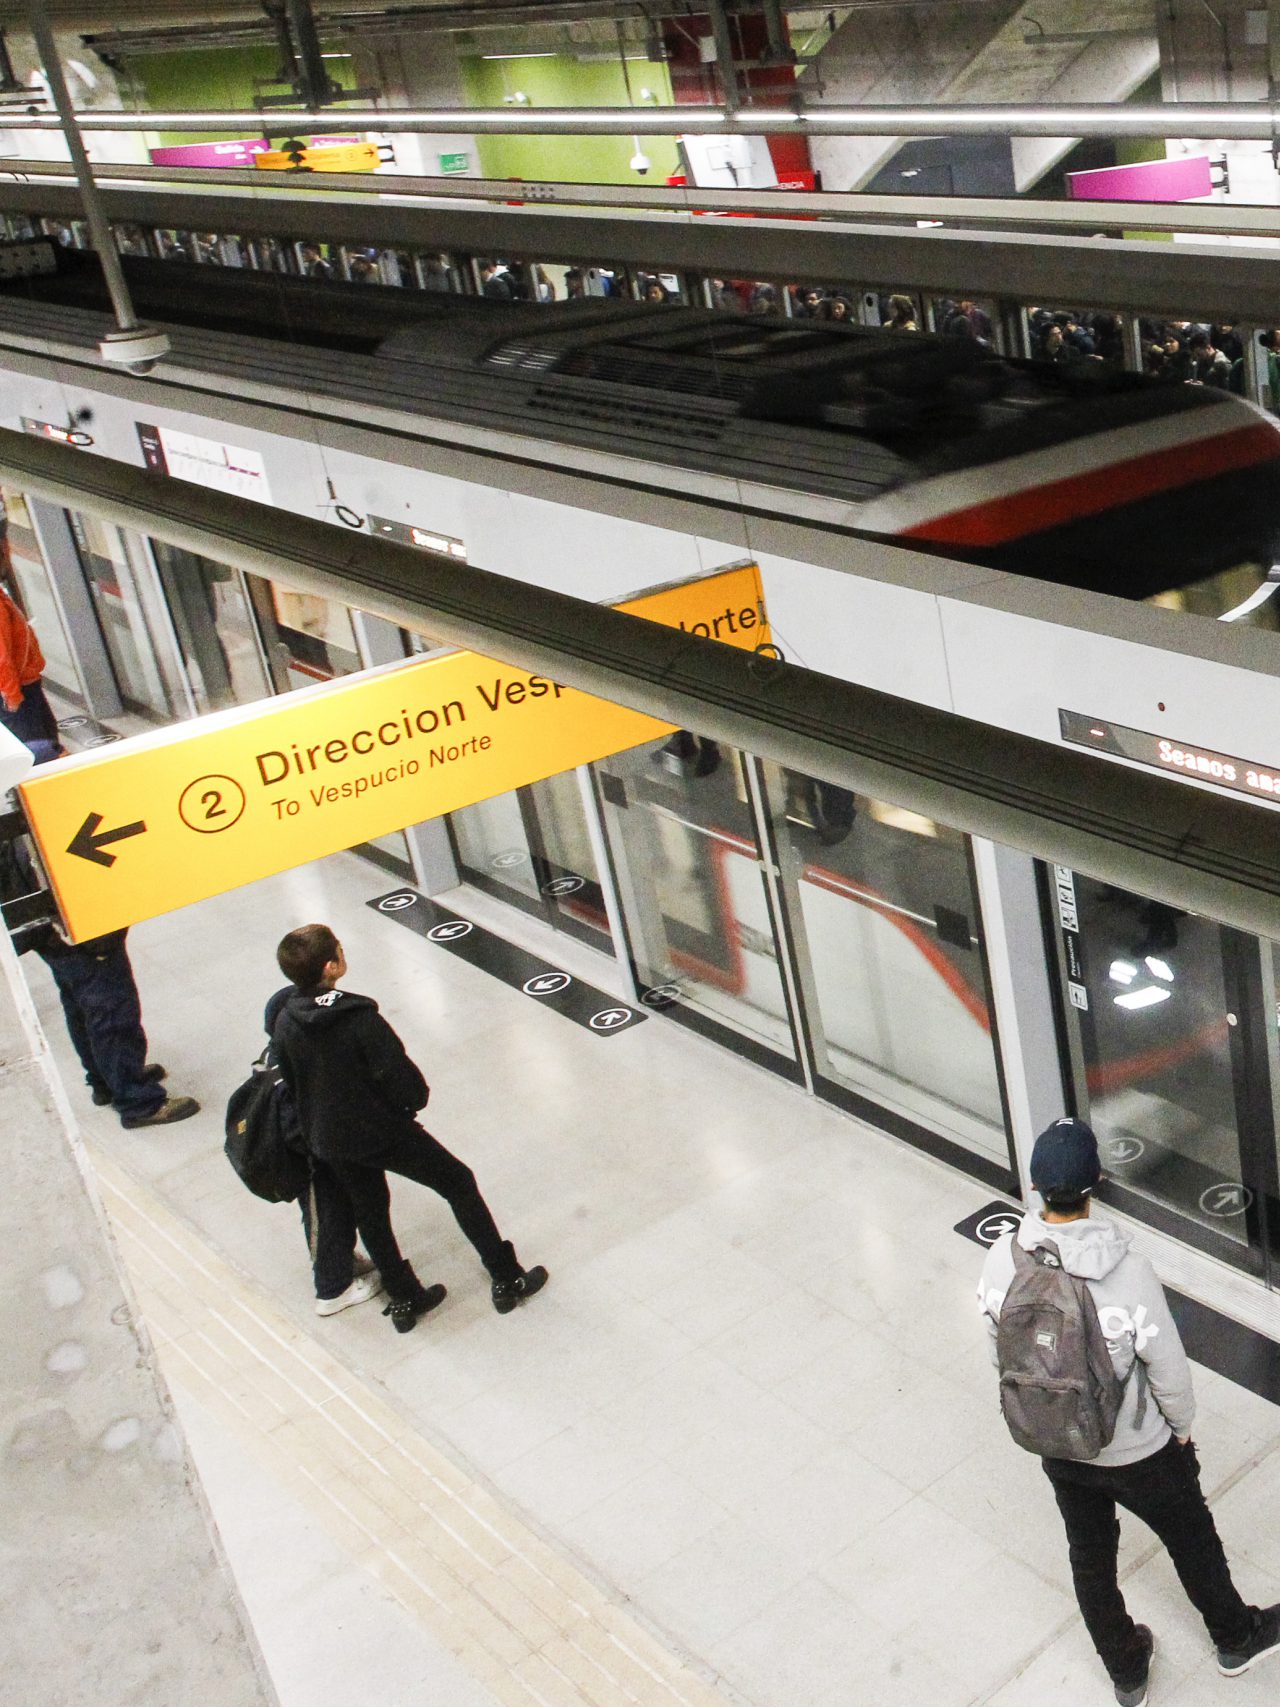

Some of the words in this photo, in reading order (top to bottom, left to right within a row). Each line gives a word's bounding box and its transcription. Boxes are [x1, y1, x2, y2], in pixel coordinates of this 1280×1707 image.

[255, 700, 466, 787] Direccion
[679, 607, 757, 638] orte
[272, 797, 300, 822] To
[309, 759, 420, 809] Vespucio
[429, 733, 493, 768] Norte
[1158, 740, 1237, 782] Seamos
[201, 790, 227, 820] 2
